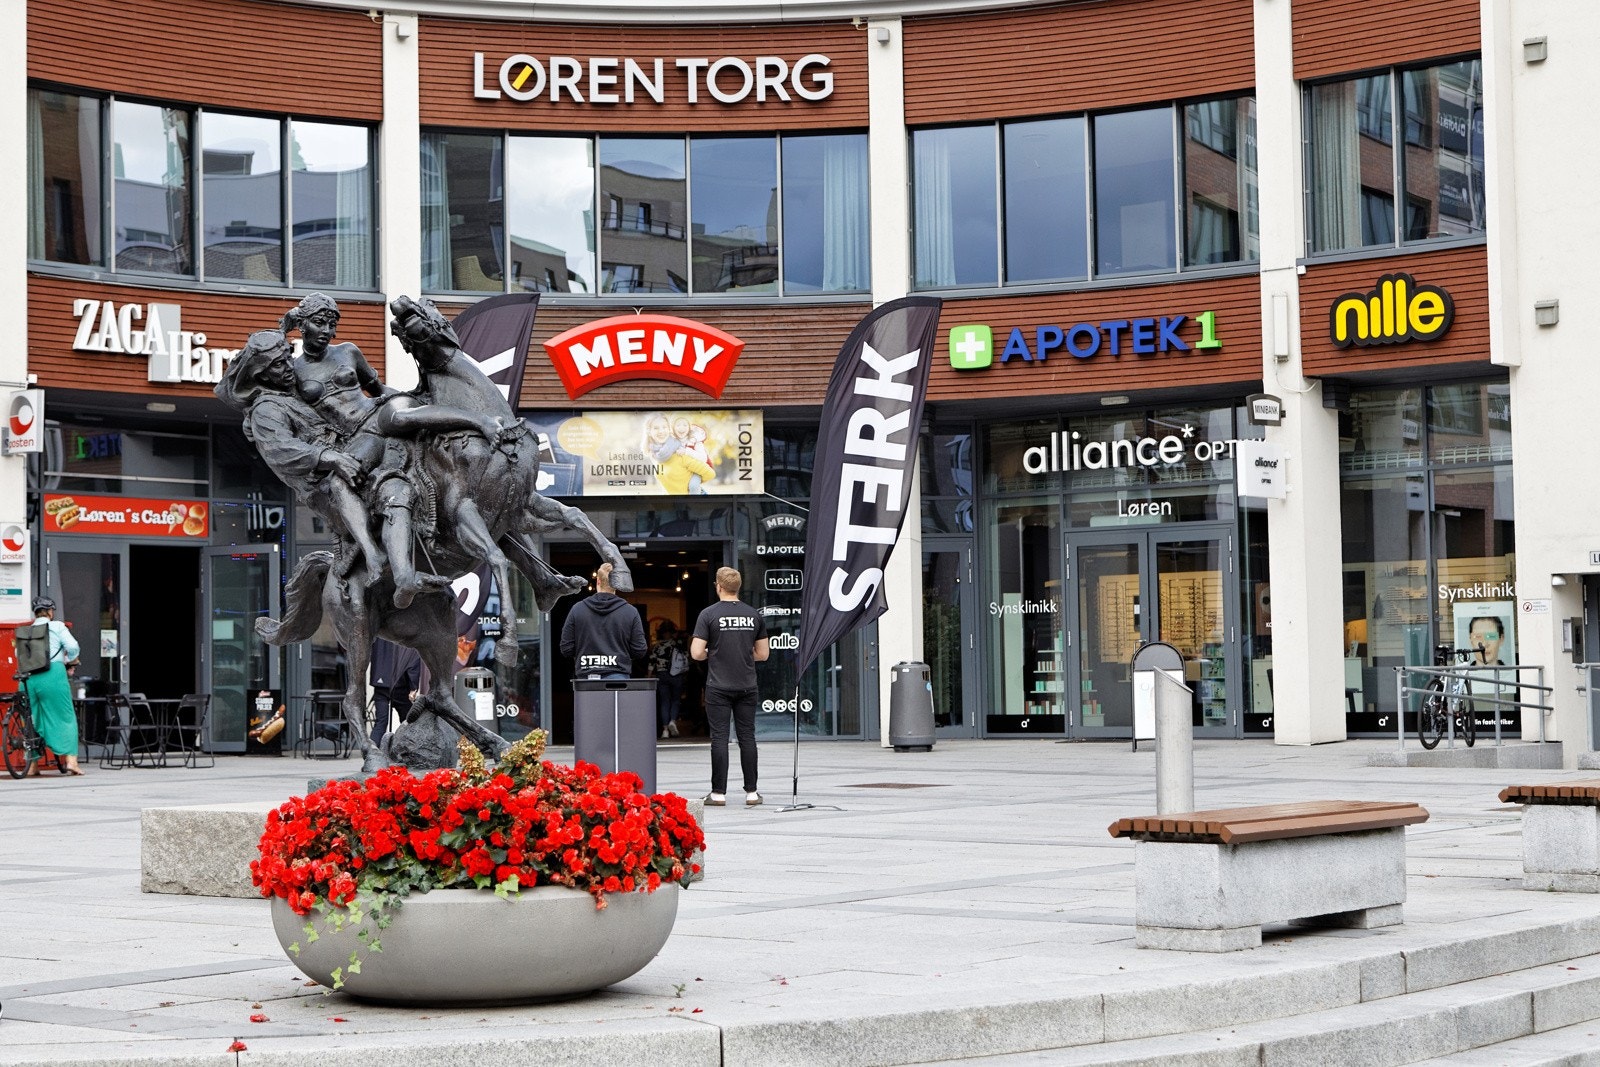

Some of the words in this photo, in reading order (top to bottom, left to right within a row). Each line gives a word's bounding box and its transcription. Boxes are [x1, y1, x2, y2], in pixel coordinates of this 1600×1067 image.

[474, 52, 664, 104] LØREN
[675, 53, 834, 104] TORG
[1335, 278, 1446, 342] nille
[73, 299, 169, 355] ZAGA
[1000, 315, 1192, 363] APOTEK
[1195, 310, 1222, 349] 1
[568, 329, 724, 377] MENY
[1254, 404, 1278, 415] MINIBANK
[608, 452, 625, 461] Last
[627, 451, 644, 461] ned
[591, 464, 664, 476] LØRENVENN!
[1118, 498, 1172, 518] Løren
[766, 516, 802, 528] MENY
[766, 545, 805, 554] APOTEK
[768, 574, 799, 585] norli
[989, 598, 1057, 618] Synsklinikk
[769, 632, 800, 650] nille
